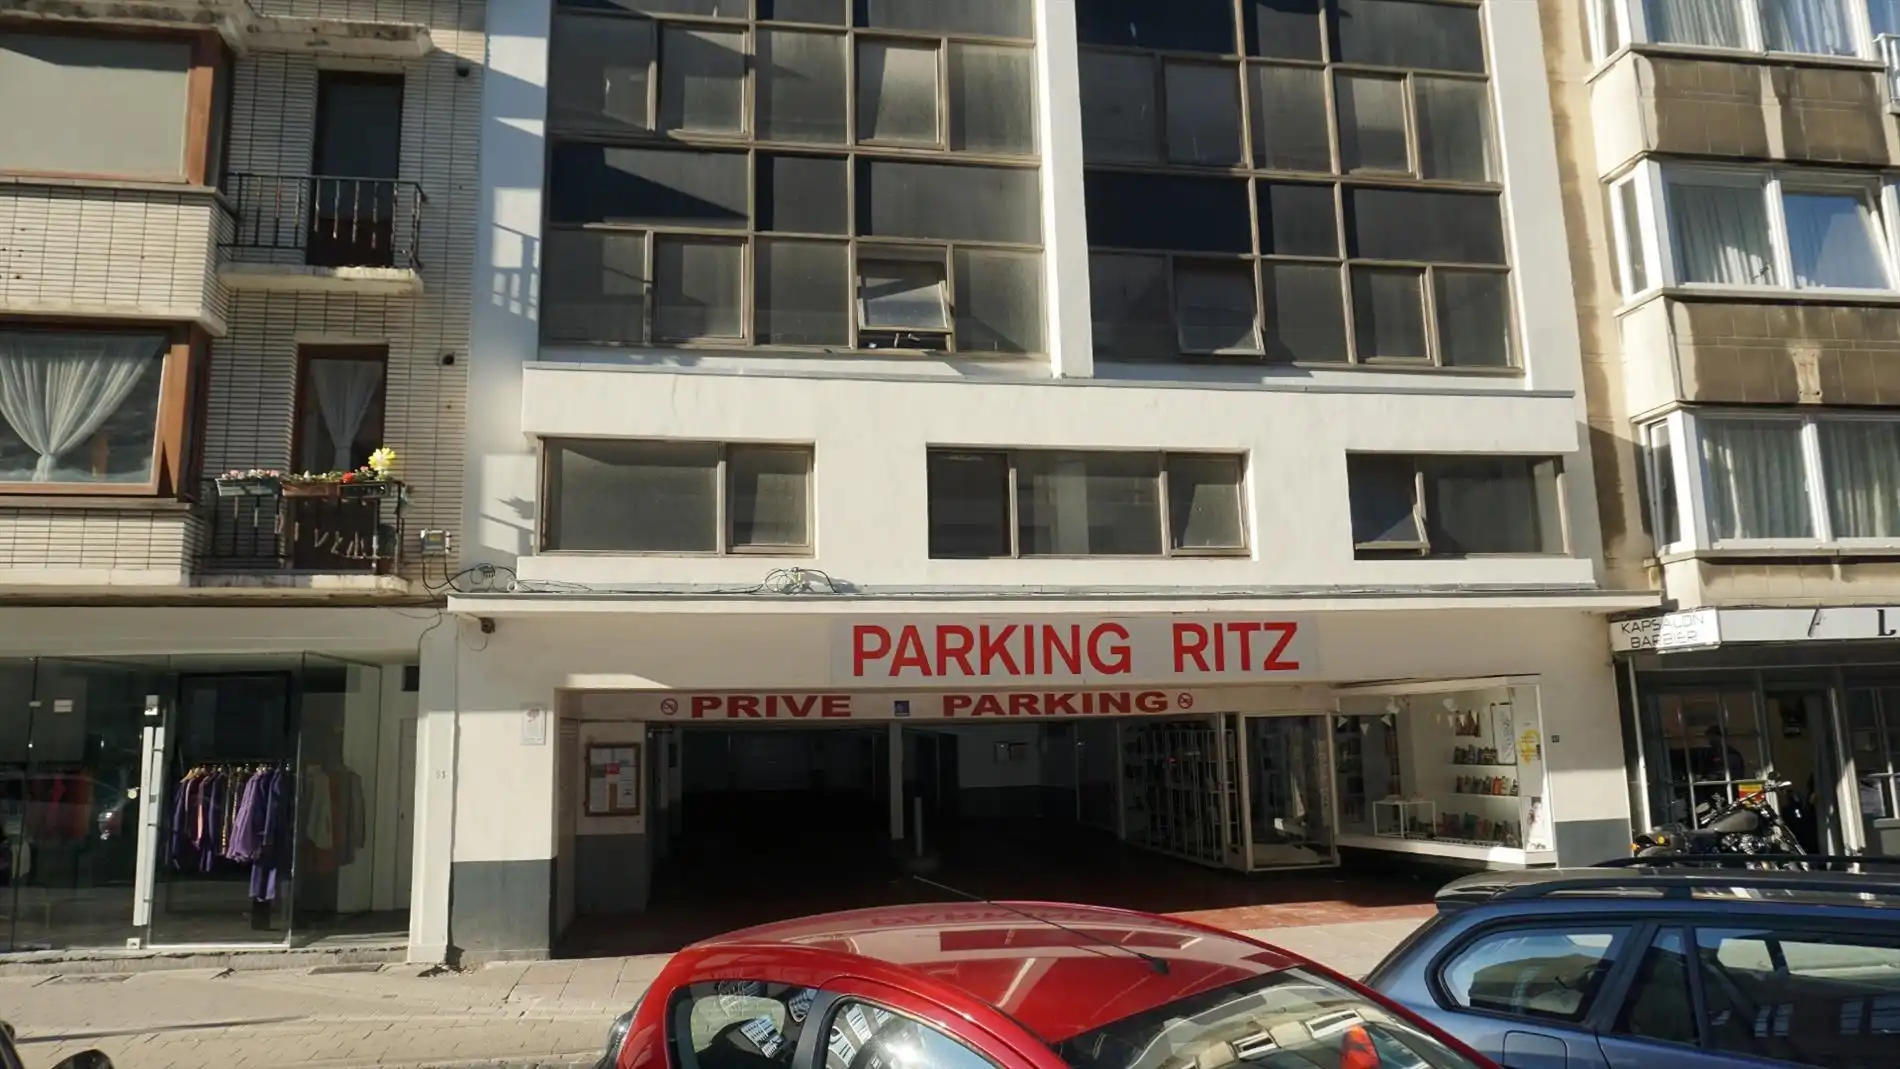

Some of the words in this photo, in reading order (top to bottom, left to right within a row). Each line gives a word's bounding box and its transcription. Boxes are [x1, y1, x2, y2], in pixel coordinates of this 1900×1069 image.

[1620, 613, 1705, 634] KAPSALON
[853, 622, 1132, 677] PARKING
[1173, 621, 1300, 673] RITZ
[1630, 630, 1698, 649] BARBIER
[690, 694, 852, 719] PRIVE
[942, 691, 1169, 718] PARKING
